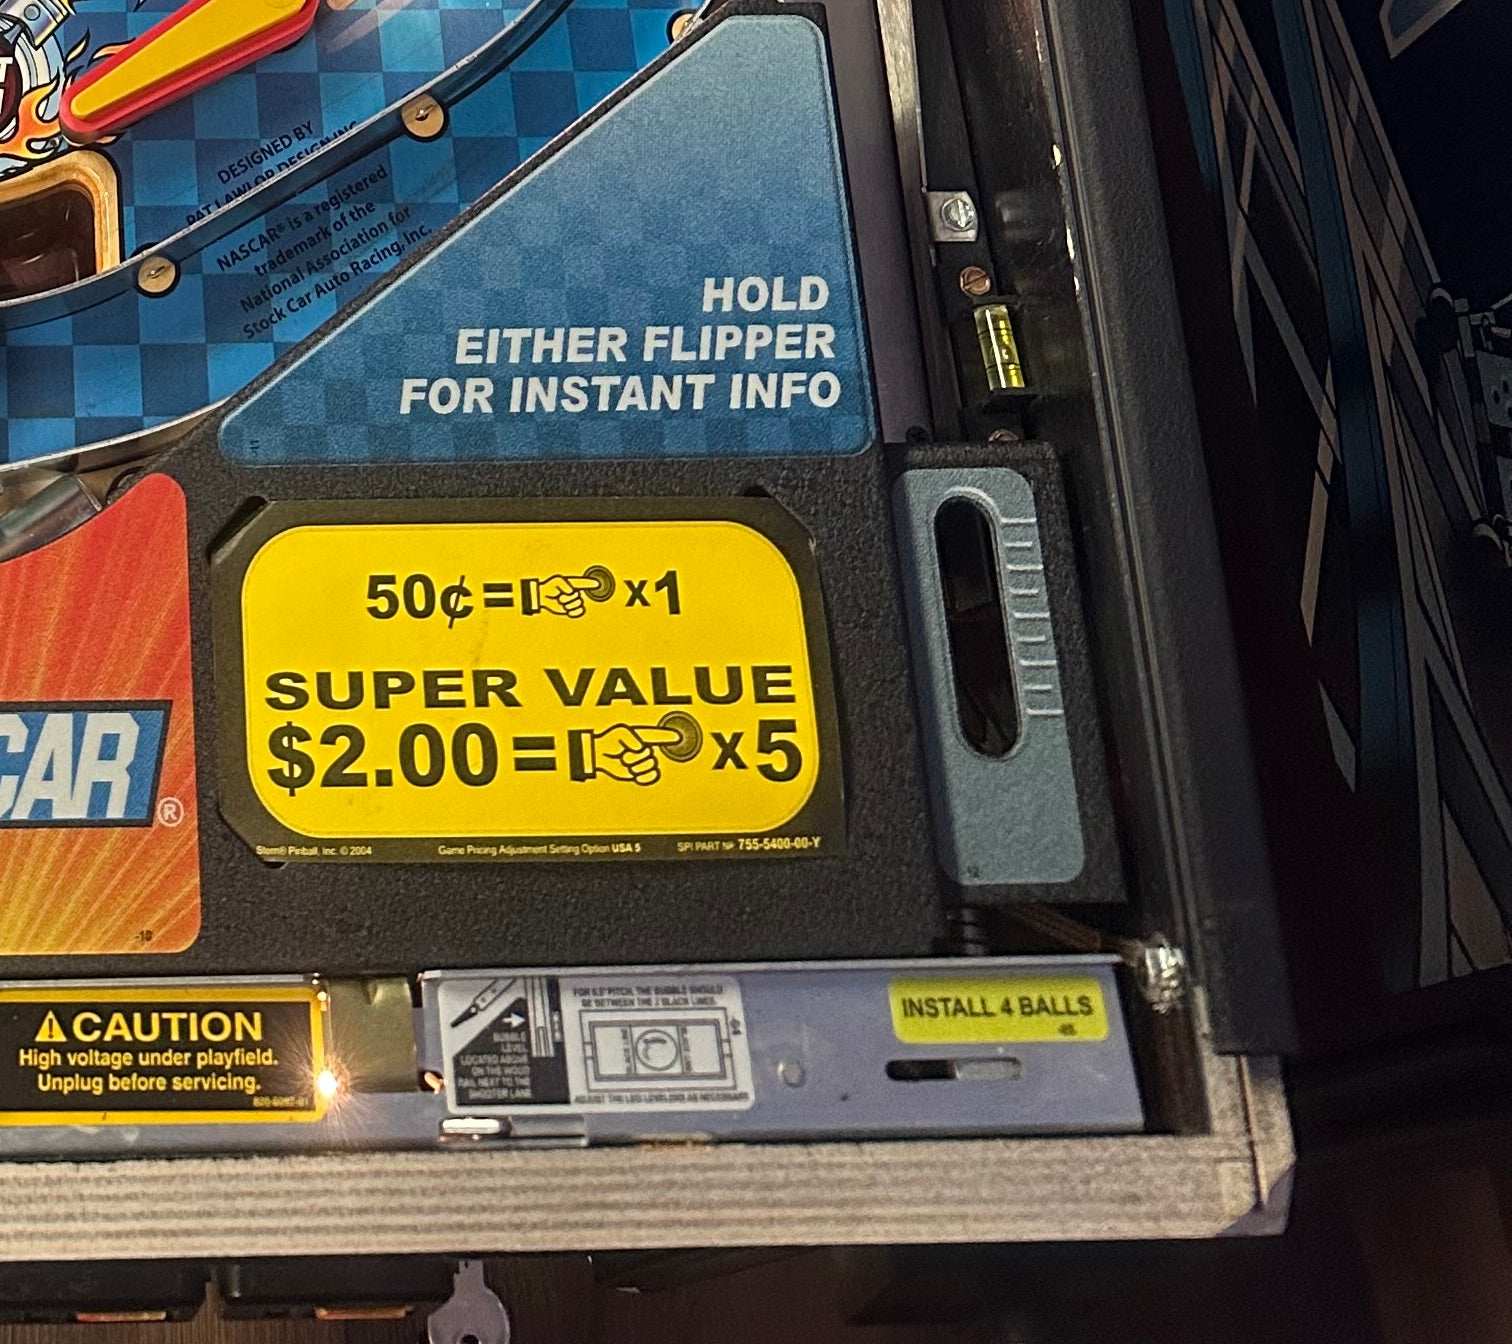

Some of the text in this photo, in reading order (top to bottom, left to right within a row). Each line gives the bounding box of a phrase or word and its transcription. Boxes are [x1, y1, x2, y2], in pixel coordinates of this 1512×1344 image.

[217, 120, 314, 186] DESIGNED BY
[313, 163, 389, 216] registered
[239, 221, 390, 314] National Association
[253, 223, 333, 278] trademark
[701, 274, 830, 313] HOLD
[454, 323, 836, 366] EITHER FLIPPER
[399, 370, 842, 415] FOR INSTANT INFO
[623, 569, 682, 617] x1
[264, 664, 797, 711] SUPER VALUE
[710, 717, 804, 784] x5
[72, 1011, 263, 1042] CAUTION
[901, 995, 1095, 1018] INSTALL 4 BALLS
[18, 1048, 278, 1071] High voltage under playfield.
[37, 1072, 261, 1096] Unplug before servicing.
